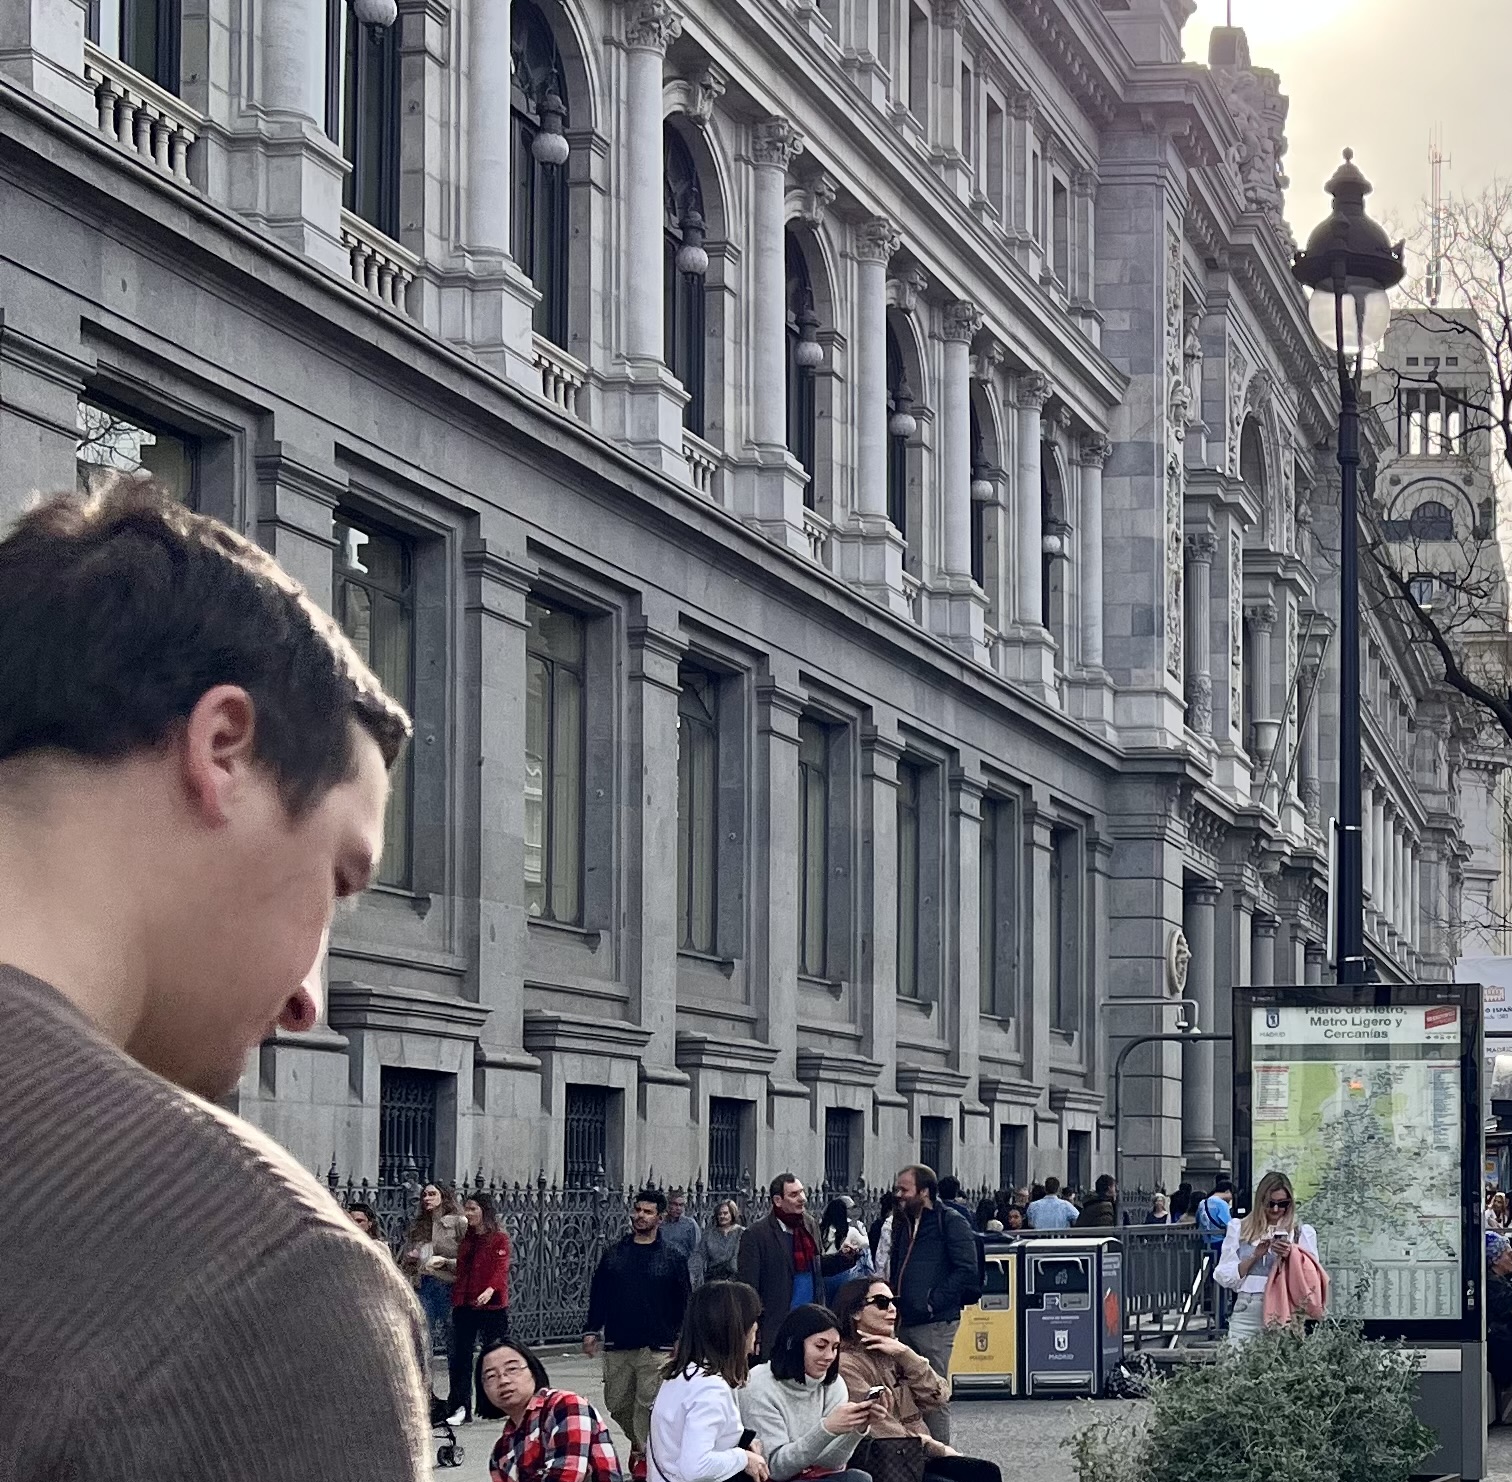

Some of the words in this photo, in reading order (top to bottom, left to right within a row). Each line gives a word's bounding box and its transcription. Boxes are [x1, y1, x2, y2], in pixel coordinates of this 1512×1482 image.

[1310, 1017, 1348, 1027] Metro
[1351, 1016, 1392, 1028] Ligero
[1395, 1018, 1403, 1028] y
[1323, 1028, 1388, 1039] Cercanías
